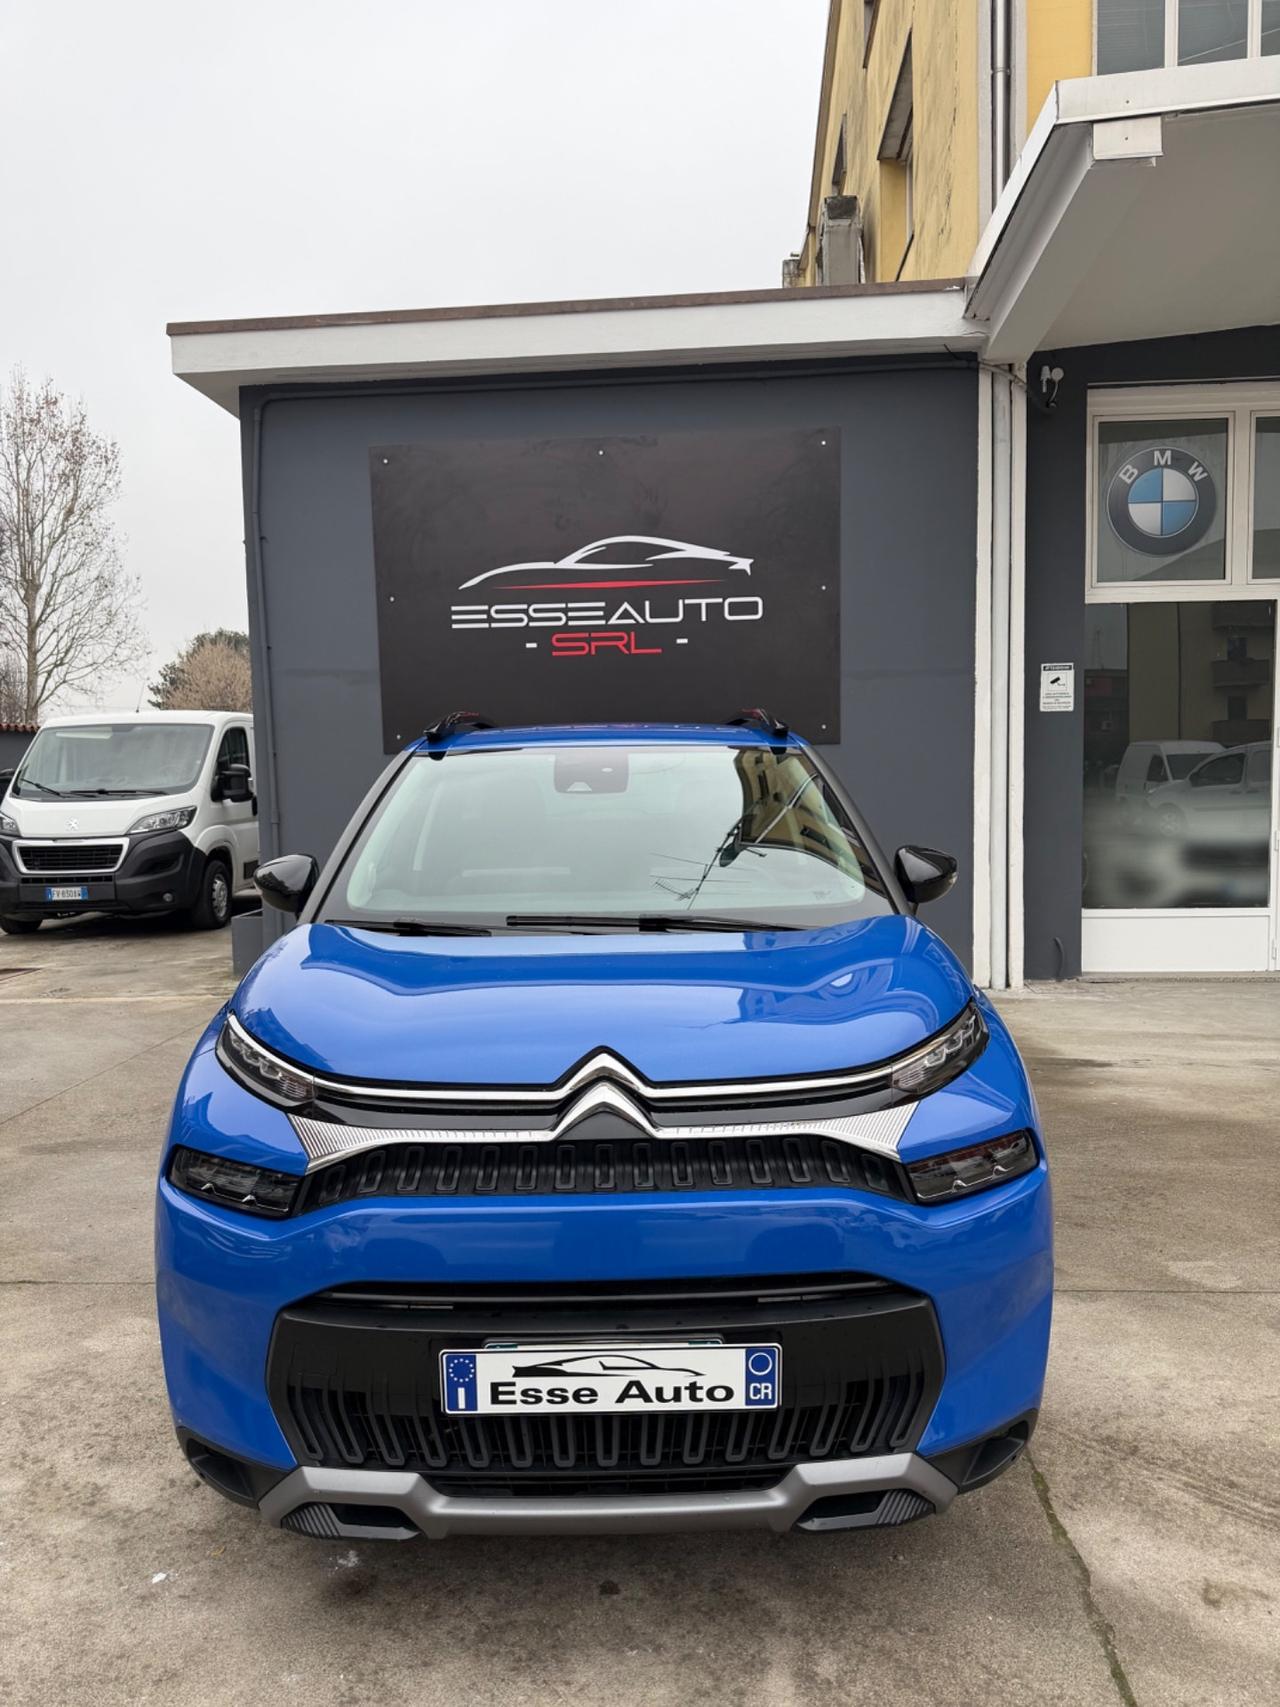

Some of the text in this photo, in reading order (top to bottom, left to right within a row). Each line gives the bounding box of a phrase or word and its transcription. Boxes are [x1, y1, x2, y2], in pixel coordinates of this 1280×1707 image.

[1119, 450, 1208, 484] BMW
[451, 596, 763, 629] ESSEAUTO
[552, 631, 662, 656] SRL
[490, 1380, 735, 1405] Esse Auto
[750, 1383, 773, 1400] CR
